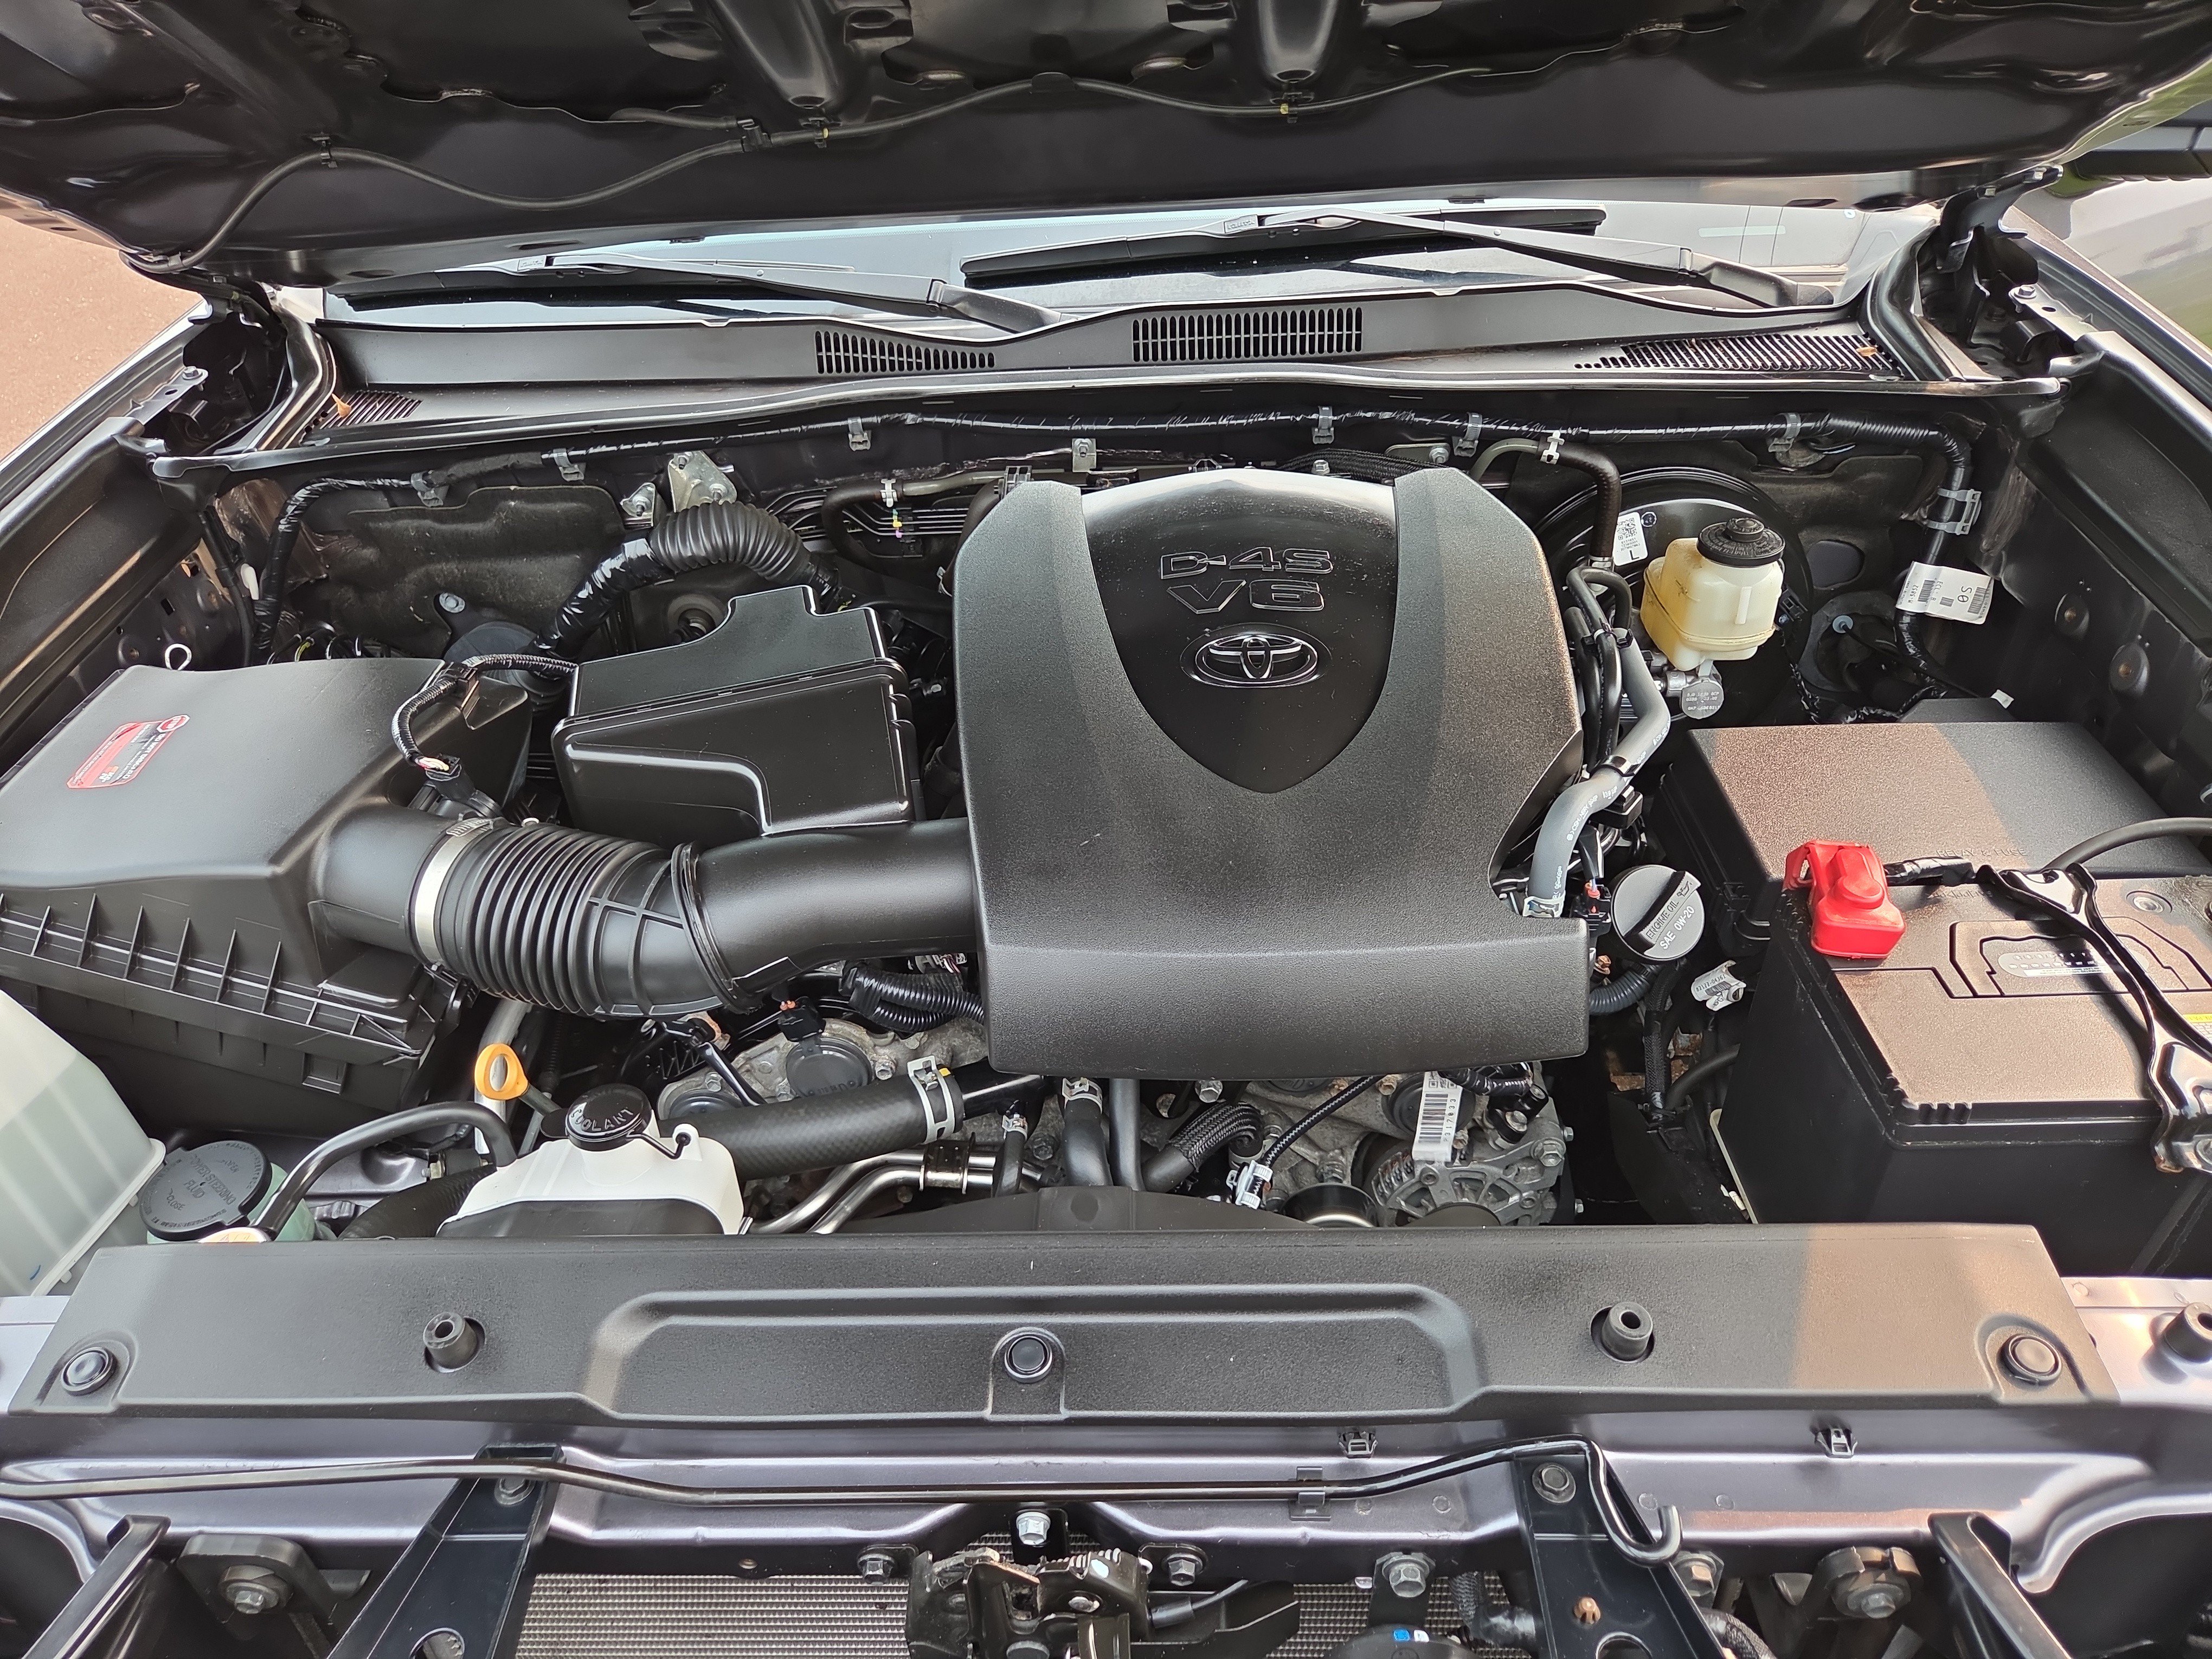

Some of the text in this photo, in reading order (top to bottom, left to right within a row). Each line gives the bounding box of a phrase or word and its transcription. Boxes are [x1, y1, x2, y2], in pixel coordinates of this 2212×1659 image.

[1160, 546, 1333, 579] D-4S
[1630, 550, 1639, 560] L
[1167, 580, 1324, 614] V6
[1994, 848, 2028, 857] FUSE
[1646, 900, 1680, 939] ENGINE OIL
[1660, 905, 1695, 949] SAE 0W-20
[570, 1108, 634, 1131] COOLANT
[166, 1194, 187, 1211] CLOSE
[183, 1179, 205, 1199] FLUID
[206, 1174, 237, 1205] STEERING
